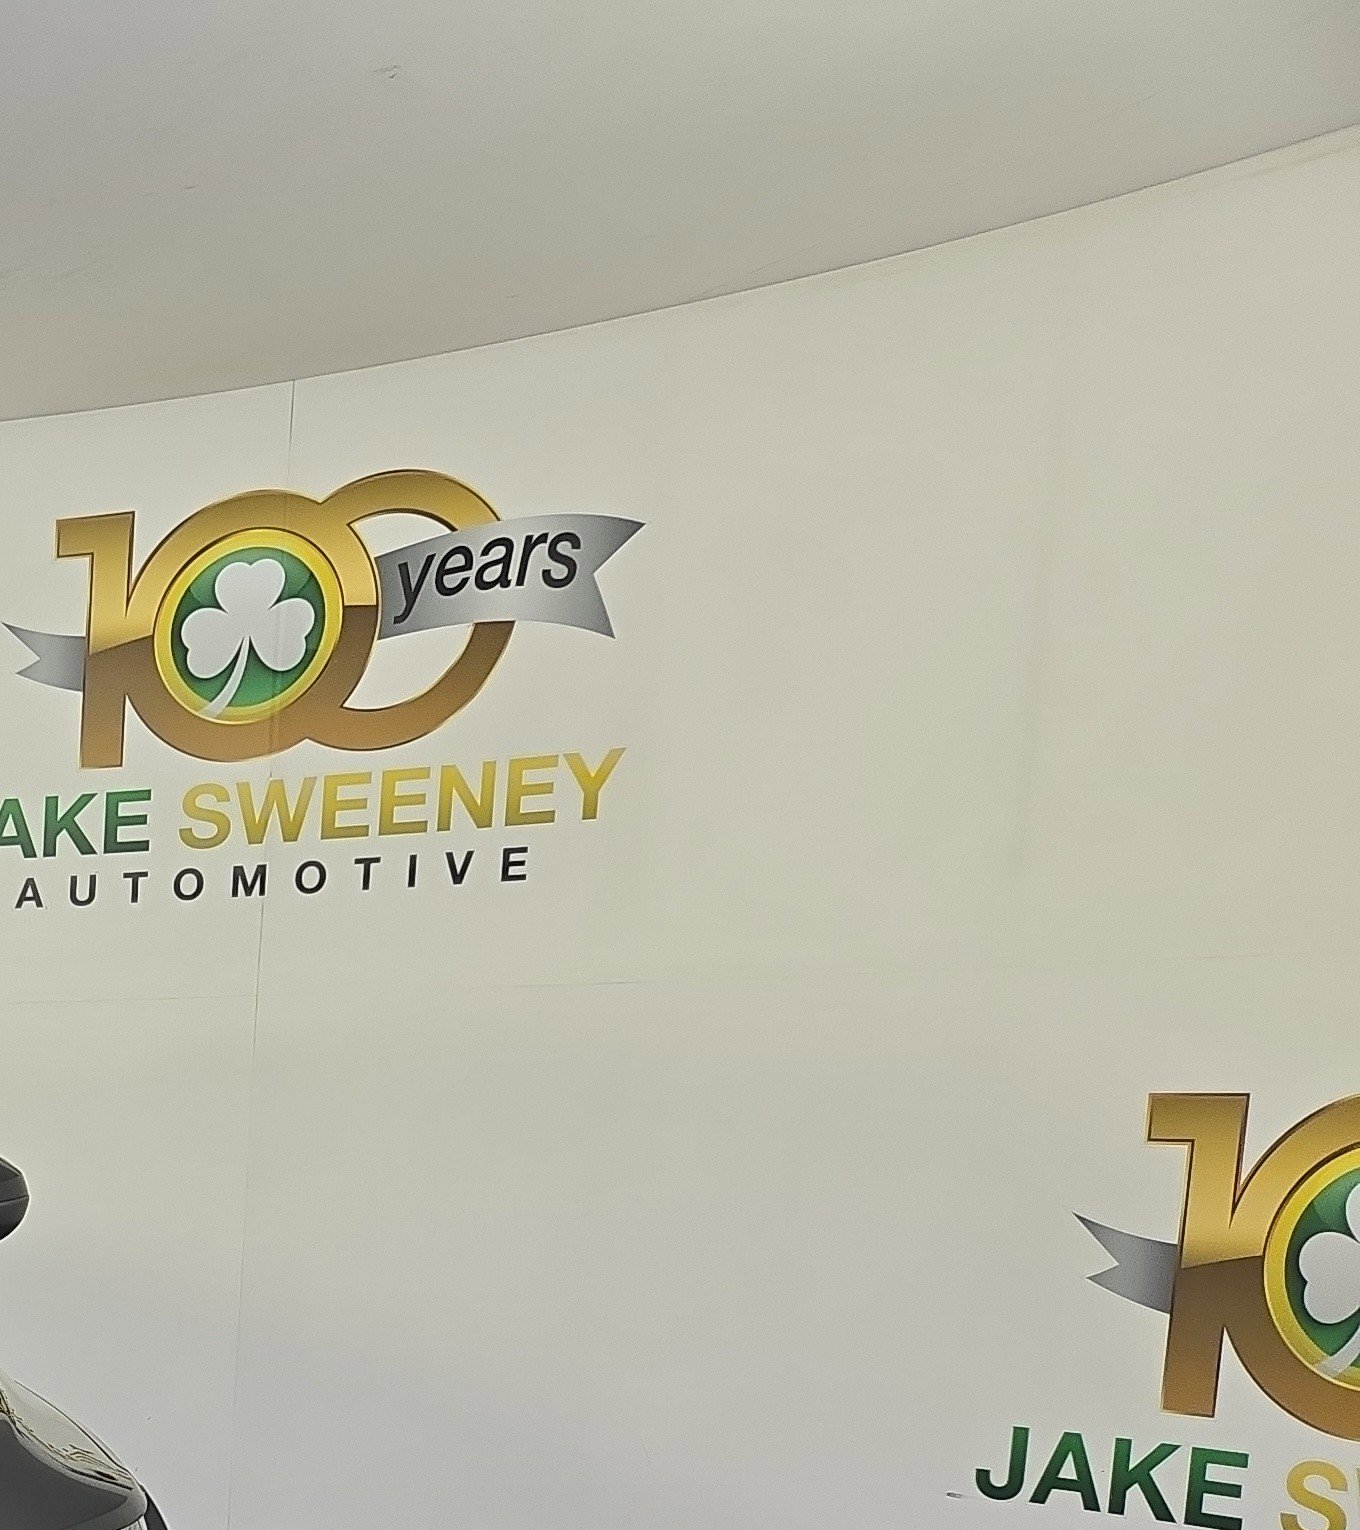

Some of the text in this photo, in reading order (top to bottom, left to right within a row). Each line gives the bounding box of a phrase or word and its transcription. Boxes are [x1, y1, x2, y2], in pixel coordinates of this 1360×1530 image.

[393, 529, 582, 625] years
[178, 747, 626, 850] SWEENEY
[14, 846, 529, 909] AUTOMOTIVE
